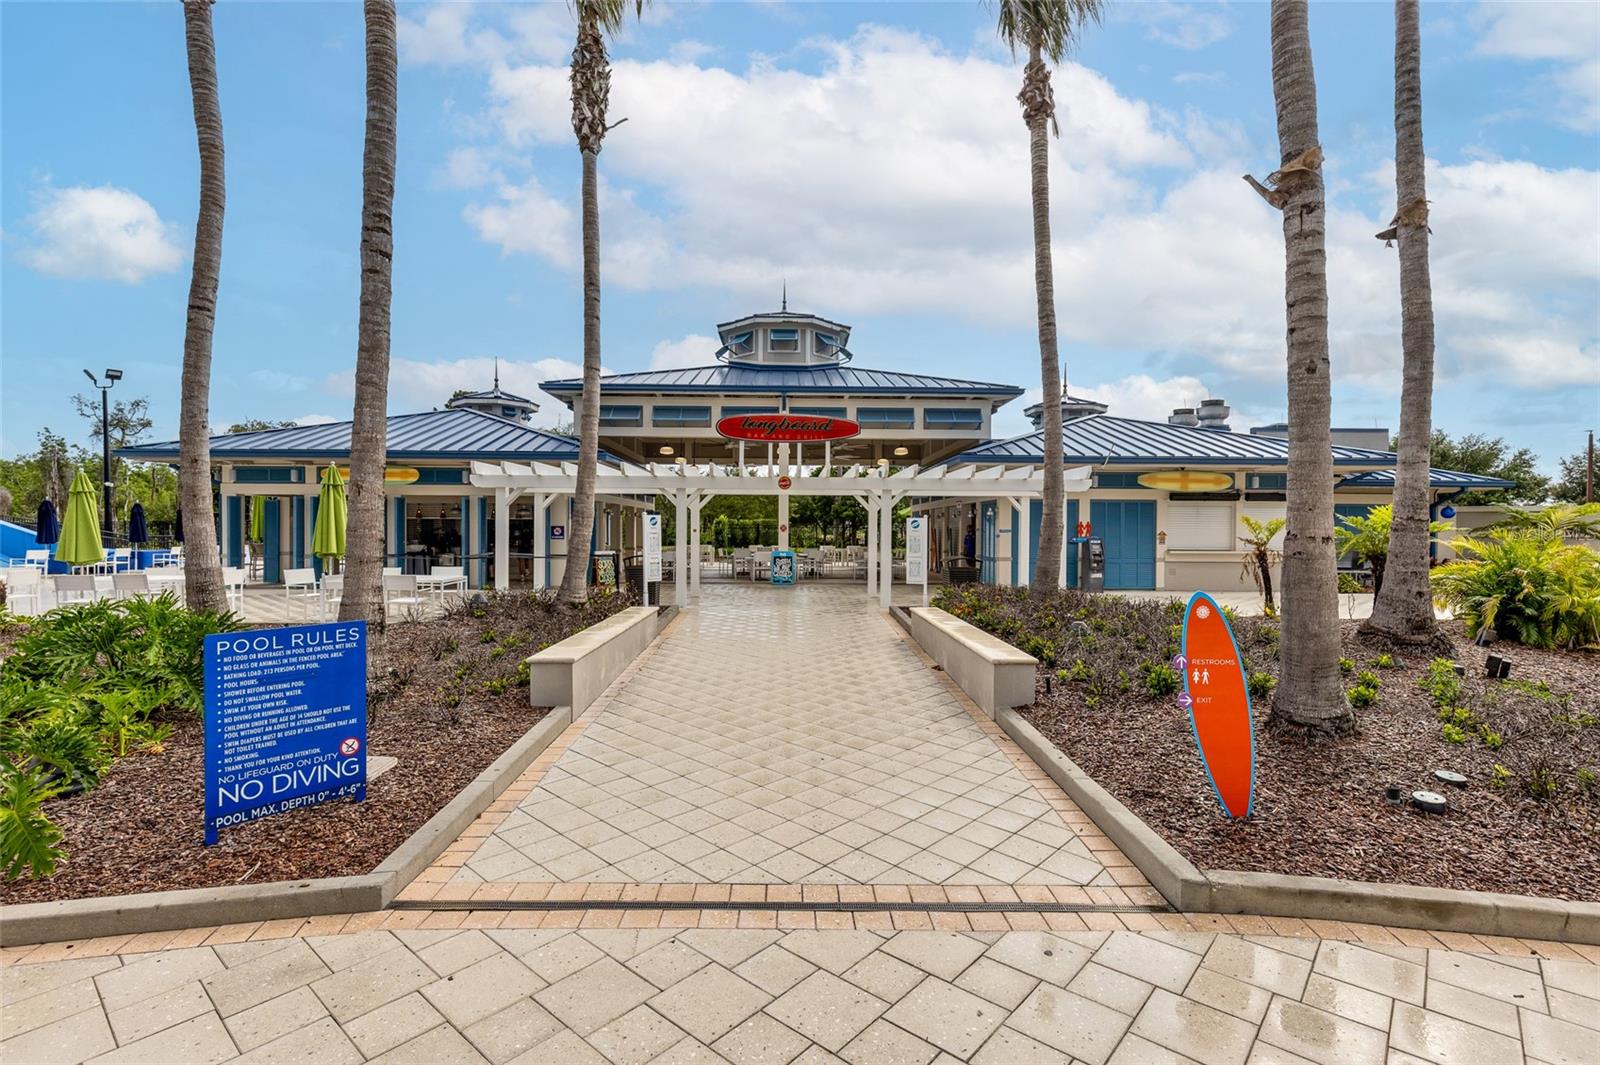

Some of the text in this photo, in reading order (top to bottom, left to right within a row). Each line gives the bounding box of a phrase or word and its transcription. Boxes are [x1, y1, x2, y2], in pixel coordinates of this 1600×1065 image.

[216, 627, 359, 655] POOL RULES
[257, 650, 284, 658] BEVERAGES
[223, 671, 246, 680] BATHING
[274, 665, 295, 673] PERSONS
[223, 688, 245, 697] SHOWER
[266, 682, 290, 690] ENTERING
[245, 693, 269, 702] SWALLOW
[224, 722, 249, 732] CHILDREN
[251, 719, 267, 727] UNDER
[303, 709, 322, 717] SHOULD
[233, 713, 252, 721] DIVING
[262, 708, 284, 716] RUNNING
[224, 731, 239, 739] POOL
[240, 727, 263, 736] WITHOUT
[273, 722, 288, 730] ADULT
[224, 740, 239, 748] SWIM
[240, 735, 262, 745] DIAPERS
[314, 721, 335, 730] CHILDREN
[224, 747, 235, 755] NOT
[236, 744, 253, 752] TOILET
[218, 752, 337, 785] NO LIFEGUARD ON DUTY
[224, 763, 242, 772] THANK
[255, 758, 265, 766] FOR
[267, 755, 280, 763] YOUR
[281, 752, 293, 760] KIND
[218, 756, 358, 807] NO DIVING
[216, 810, 248, 828] POOL
[251, 803, 277, 819] MAX.
[281, 793, 314, 811] DEPTH
